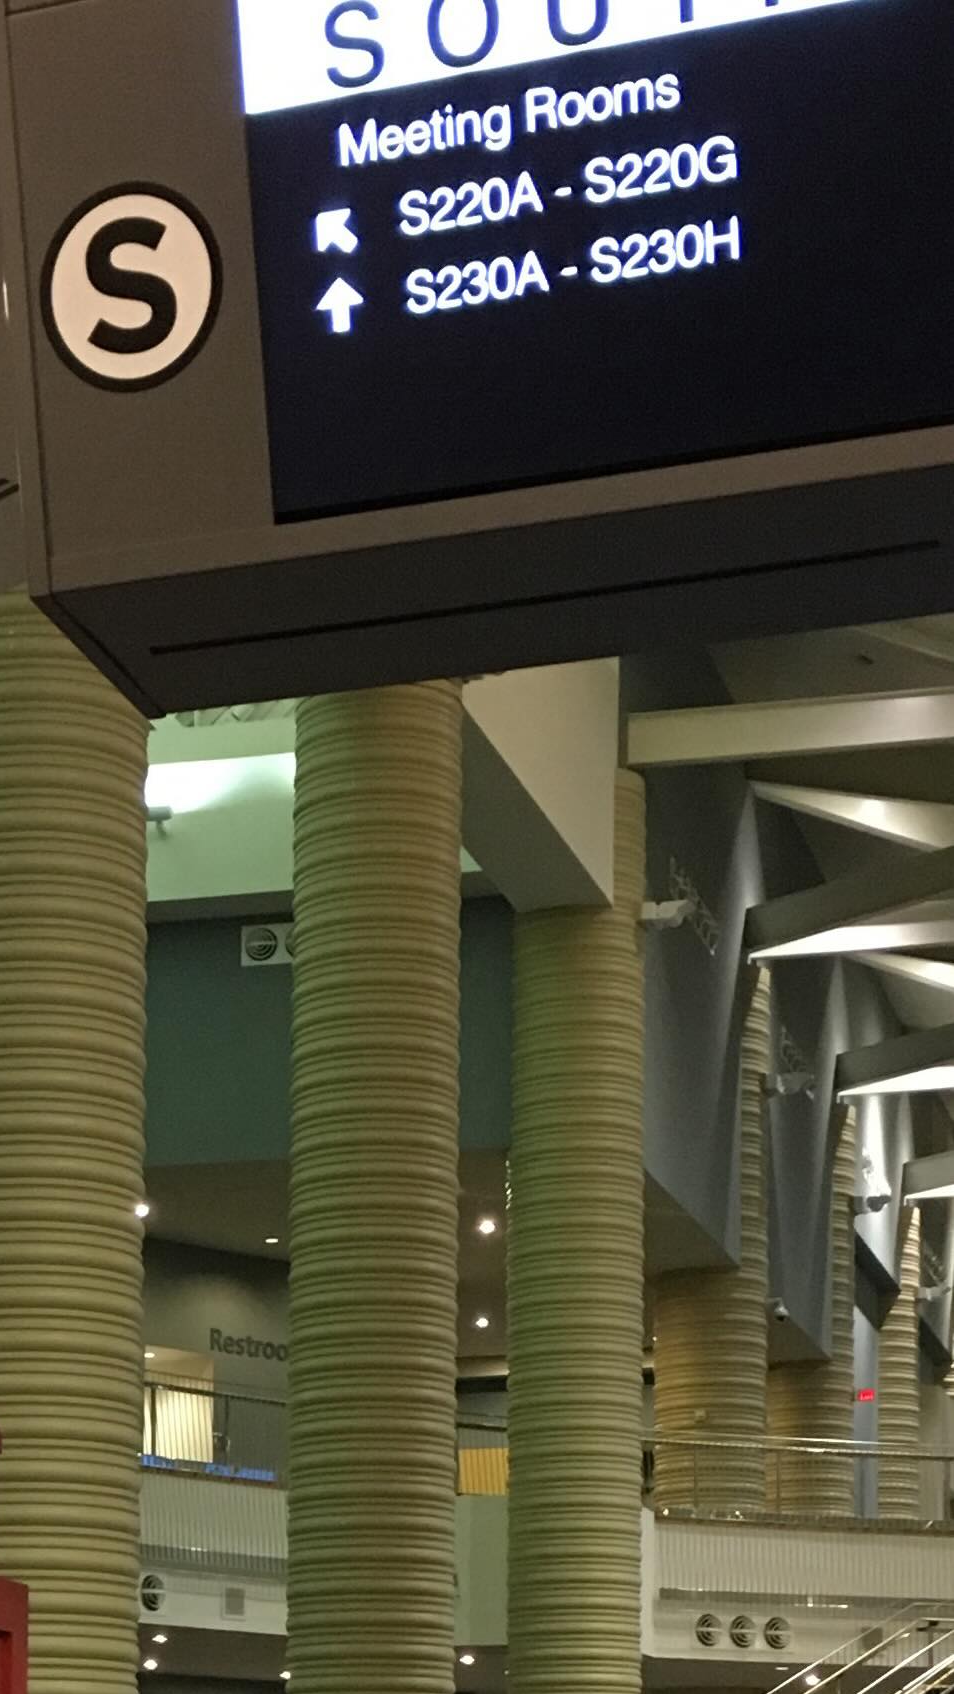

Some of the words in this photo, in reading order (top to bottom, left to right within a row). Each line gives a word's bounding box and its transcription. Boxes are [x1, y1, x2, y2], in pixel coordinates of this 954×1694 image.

[324, 0, 780, 88] SOU
[338, 103, 512, 167] Meeting
[524, 73, 682, 133] Rooms
[398, 171, 544, 236] S220A
[583, 136, 738, 203] S220G
[84, 217, 178, 354] S
[405, 251, 550, 314] S230A
[589, 216, 742, 284] S230H
